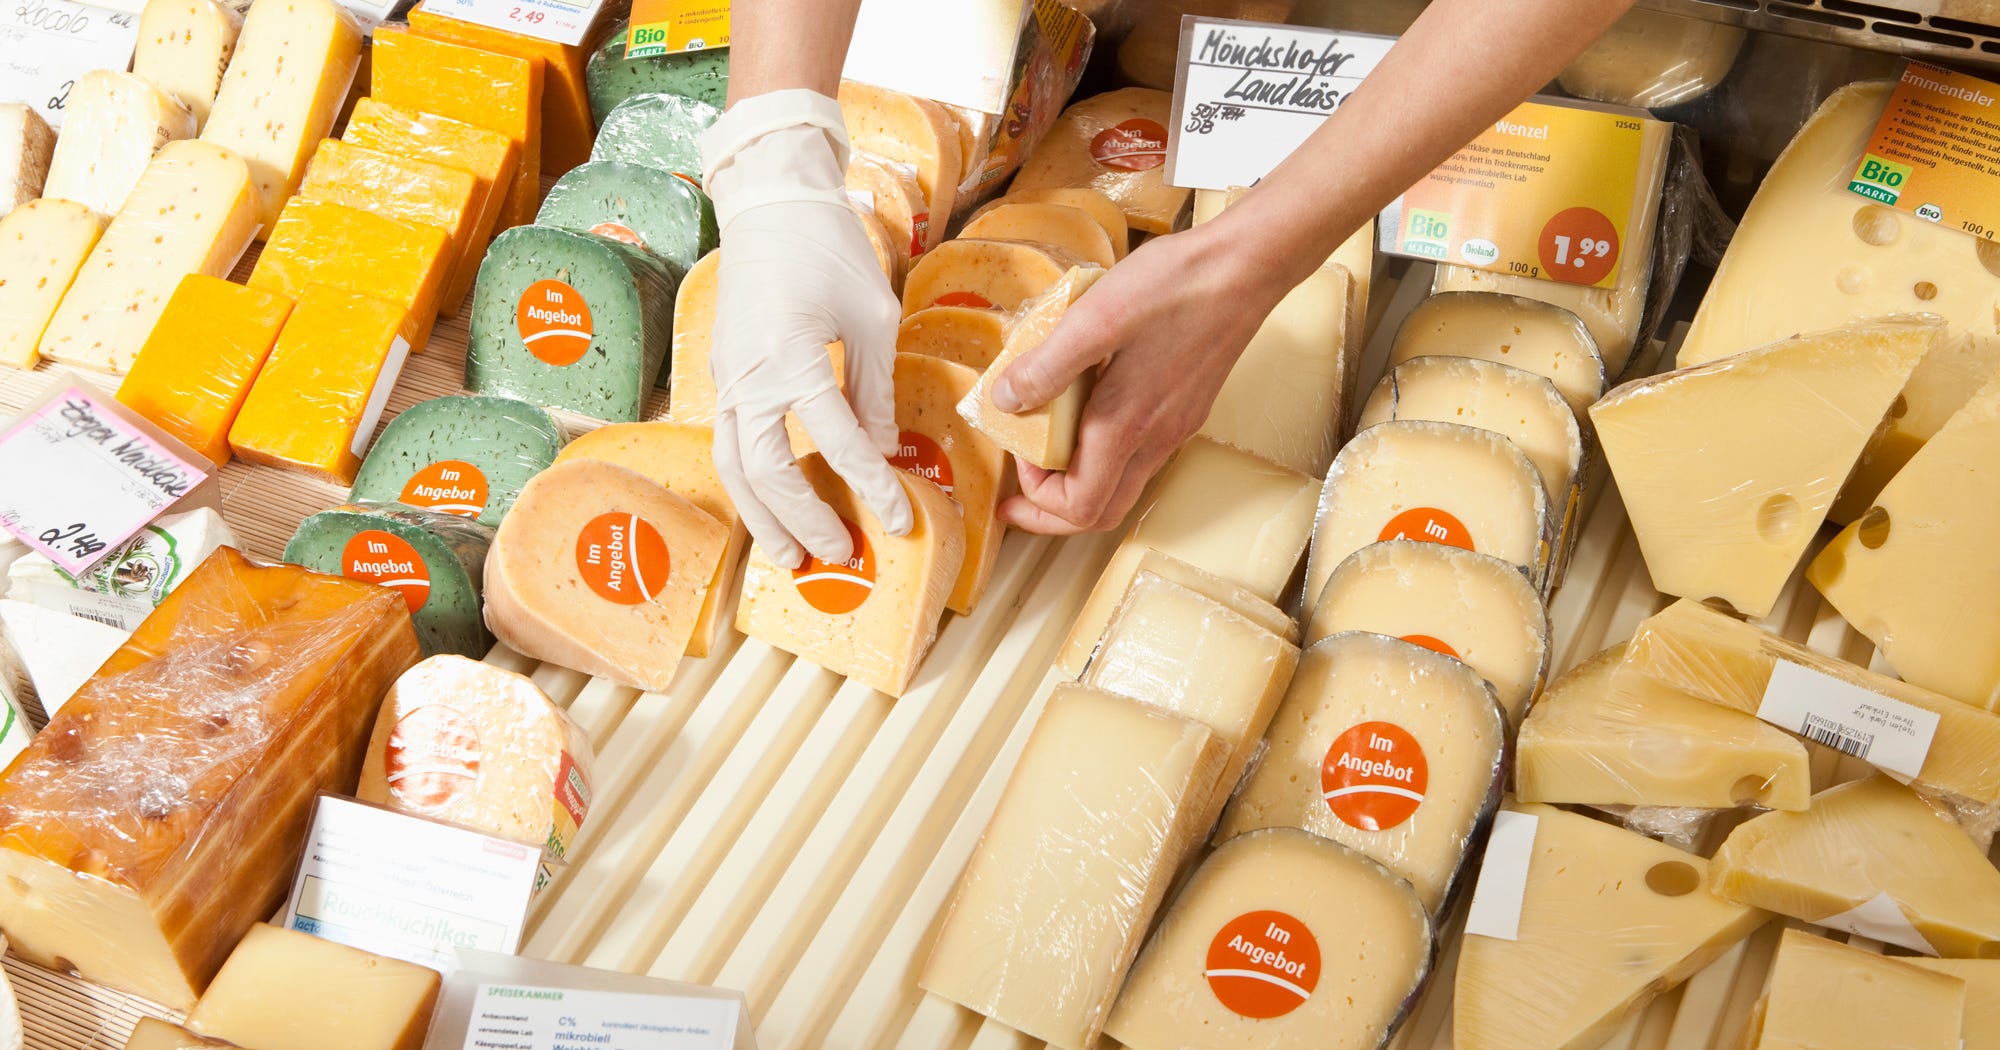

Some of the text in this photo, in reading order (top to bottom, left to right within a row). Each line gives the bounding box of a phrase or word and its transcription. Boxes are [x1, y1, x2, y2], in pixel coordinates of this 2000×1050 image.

[509, 7, 545, 24] 2,49
[634, 28, 665, 44] Bio
[631, 47, 662, 57] MARKT
[1900, 70, 1995, 108] Emmentaler
[1910, 99, 2000, 131] Bio-Hartkäse aus Österre
[1495, 120, 1549, 140] Wenzel
[1614, 120, 1642, 131] 125425
[1901, 117, 2000, 153] Kuhmilch, mikrobielles Lab
[1905, 109, 2000, 142] min. 45% Fett in Trocken
[1102, 139, 1162, 149] Angebot
[1895, 128, 2000, 165] Rindengereift, Rinde verzeh
[1469, 155, 1483, 164] Fett
[1485, 157, 1492, 165] in
[1494, 159, 1544, 174] Trockenmasse
[1491, 147, 1505, 156] aus
[1506, 148, 1551, 163] Deutschland
[1885, 147, 1937, 169] pikant-nussig
[1891, 137, 2000, 177] mit Rohmilch hergestellt, lac
[1430, 173, 1495, 190] würzig-aromatisch
[1468, 167, 1513, 181] mikrobielles
[1513, 173, 1527, 183] Lab
[1861, 159, 1903, 187] Bio
[1854, 183, 1894, 203] MARKT
[1411, 213, 1448, 239] Bio
[1961, 221, 1995, 240] 100 g
[1407, 241, 1444, 258] MARKT
[1465, 242, 1495, 258] Bioland
[1555, 234, 1610, 269] 1.99
[1509, 261, 1539, 277] 100 g
[546, 289, 563, 304] Im
[527, 305, 582, 326] Angebot
[898, 444, 918, 458] Im
[440, 468, 460, 481] Im
[907, 463, 941, 479] ebot
[413, 484, 476, 501] Angebot
[1424, 519, 1449, 540] Im
[38, 522, 107, 559] 2.49
[367, 540, 388, 554] Im
[586, 544, 601, 565] Im
[607, 524, 627, 592] Angebot
[353, 559, 415, 577] Angebot
[1369, 733, 1393, 752] Im
[1337, 751, 1414, 783] Angebot
[1265, 921, 1291, 945] Im
[1227, 934, 1306, 979] Angebot
[487, 986, 565, 1001] SPEISEKAMMER
[555, 1031, 611, 1044] mikrobiell
